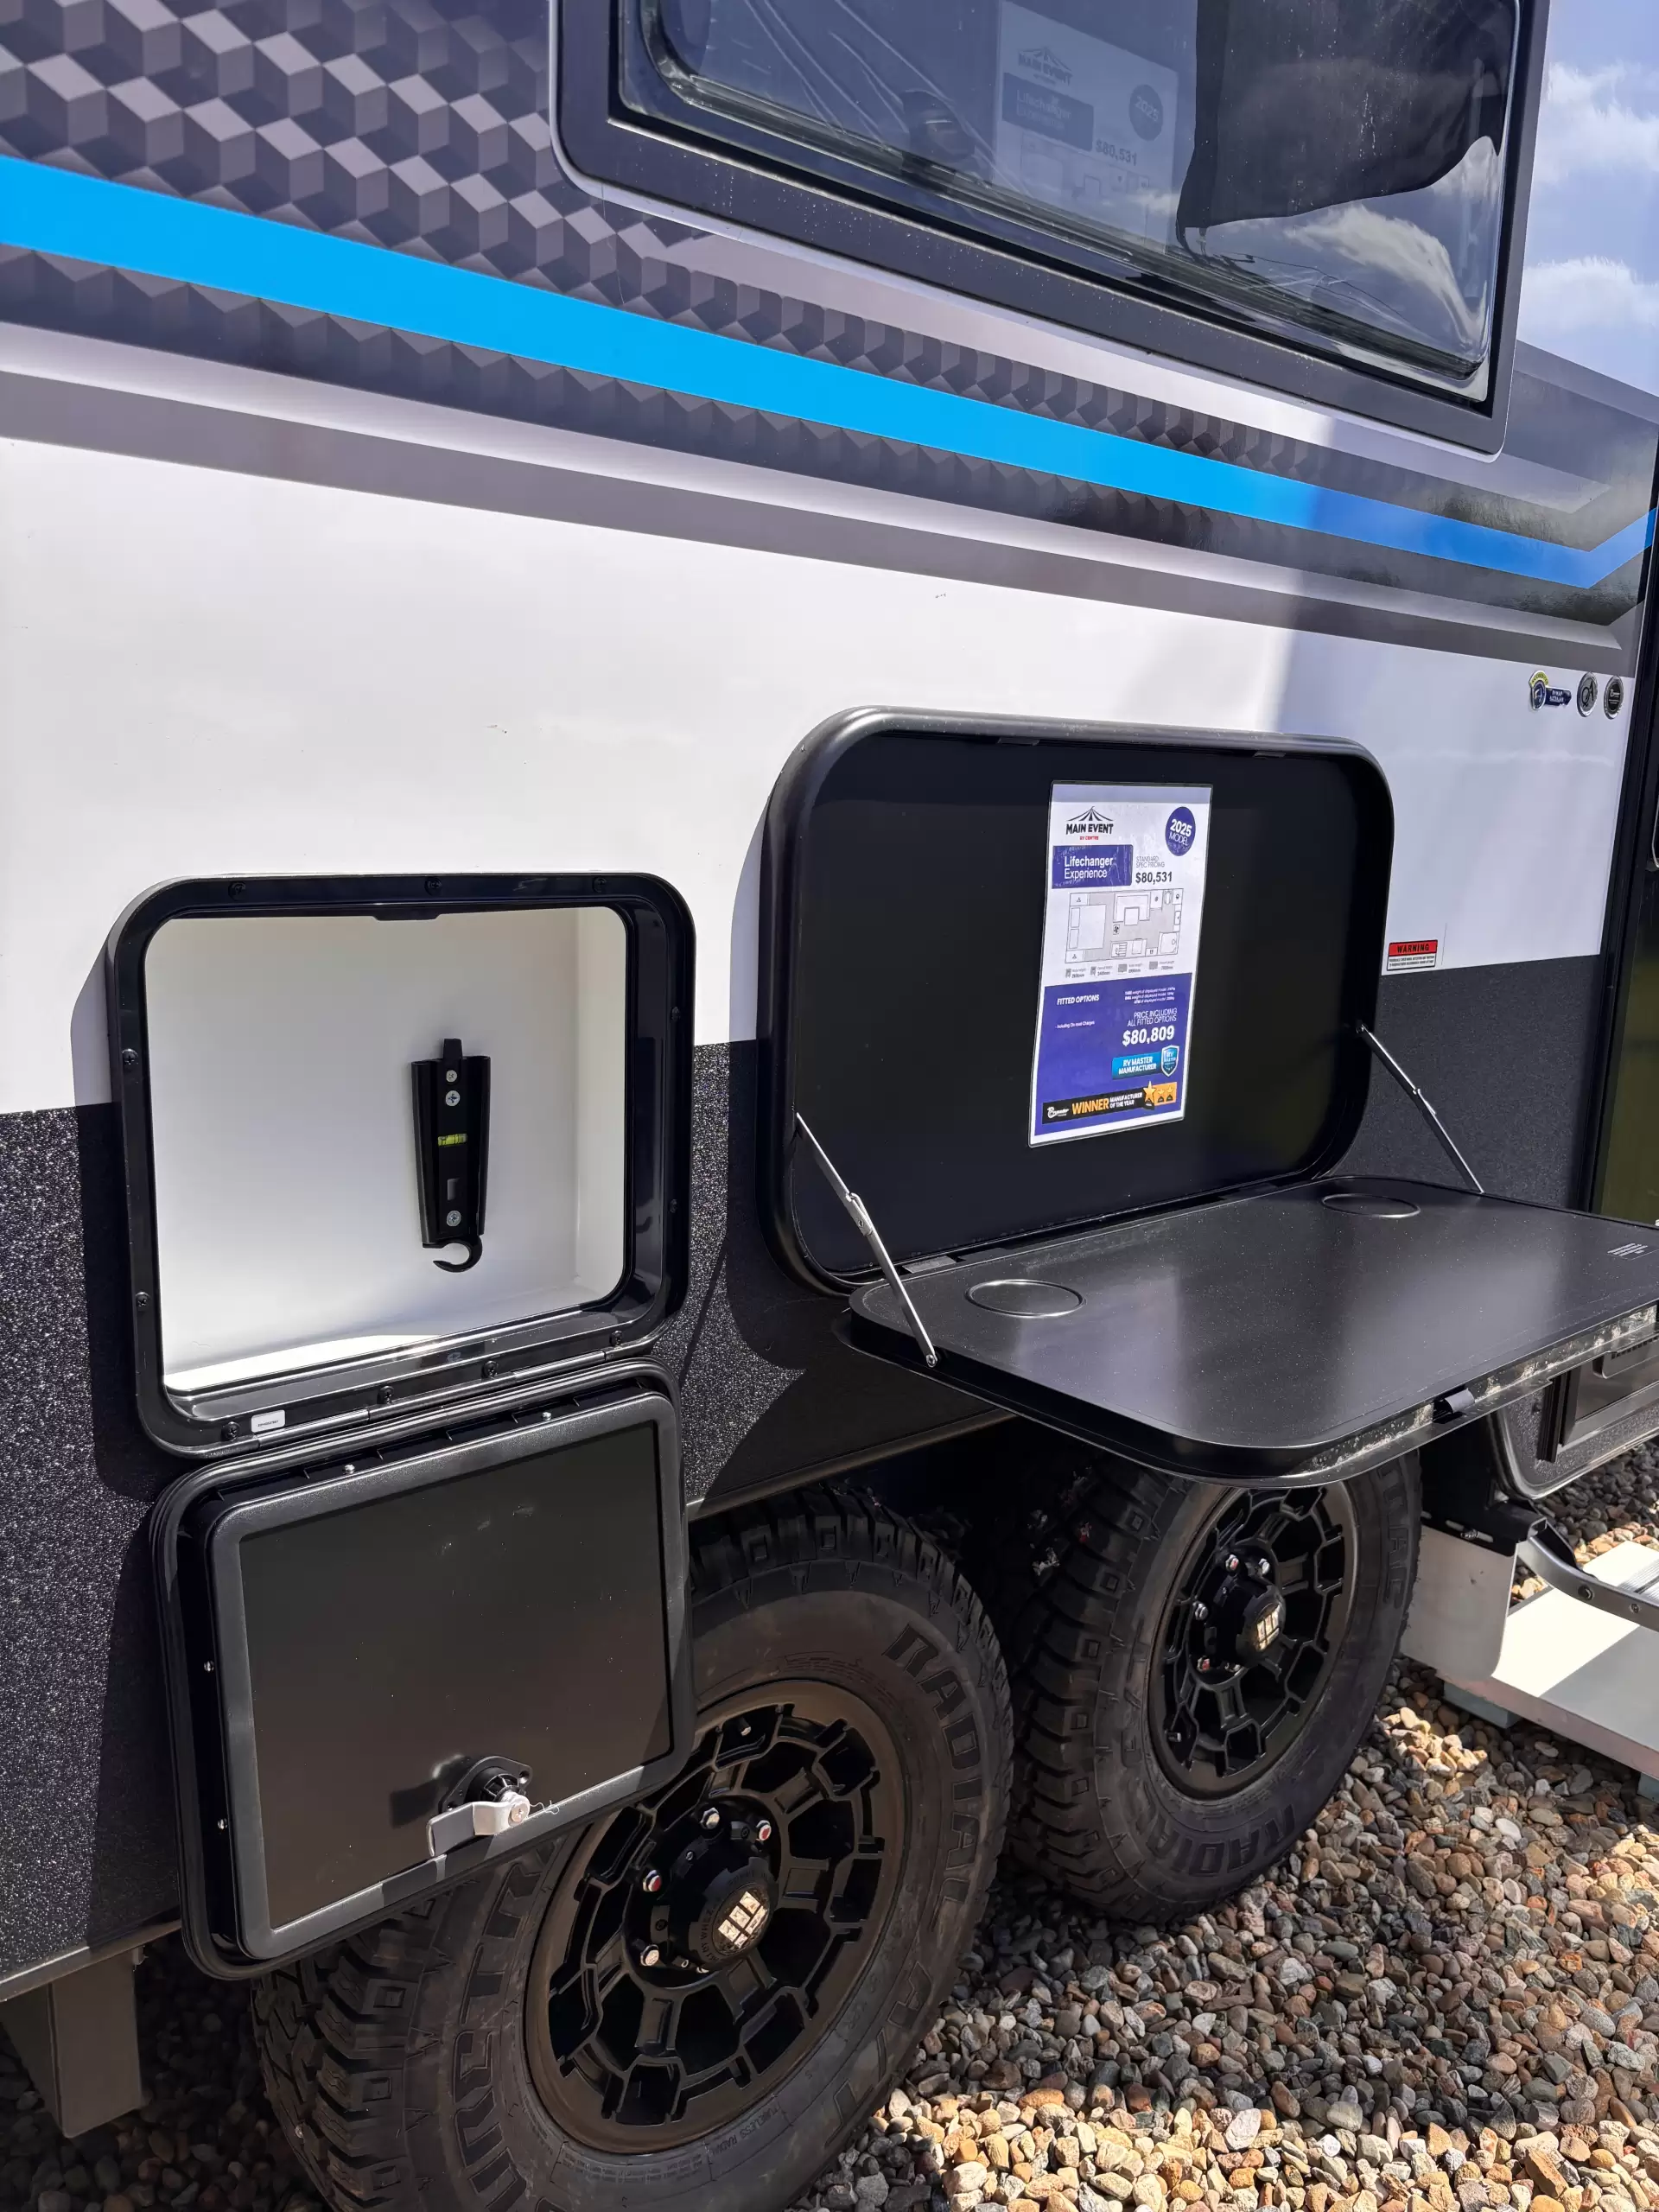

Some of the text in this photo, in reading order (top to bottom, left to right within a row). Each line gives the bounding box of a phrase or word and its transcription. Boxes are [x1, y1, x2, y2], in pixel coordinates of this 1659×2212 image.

[1135, 96, 1160, 122] 2025
[1096, 139, 1137, 166] $80,531
[1065, 823, 1114, 835] MAIN EVENT
[1170, 818, 1192, 837] 2025
[1169, 831, 1188, 846] MODEL
[1064, 855, 1114, 868] Lifechanger
[1064, 868, 1108, 881] Experience
[1135, 871, 1173, 885] $80,531
[1396, 944, 1430, 953] WARNING
[1057, 995, 1100, 1006] FITTED OPTIONS
[1134, 1007, 1178, 1019] PRICE INCLUDING
[1136, 1017, 1154, 1026] FITTED
[1154, 1014, 1177, 1024] OPTIONS
[1122, 1025, 1175, 1047] $80,809
[1132, 1056, 1154, 1065] MASTER
[1118, 1063, 1157, 1075] MANUFACTURER
[1109, 1091, 1143, 1102] MANUFACTURER
[1071, 1097, 1109, 1116] WINNER
[882, 1623, 982, 1934] RADIAL
